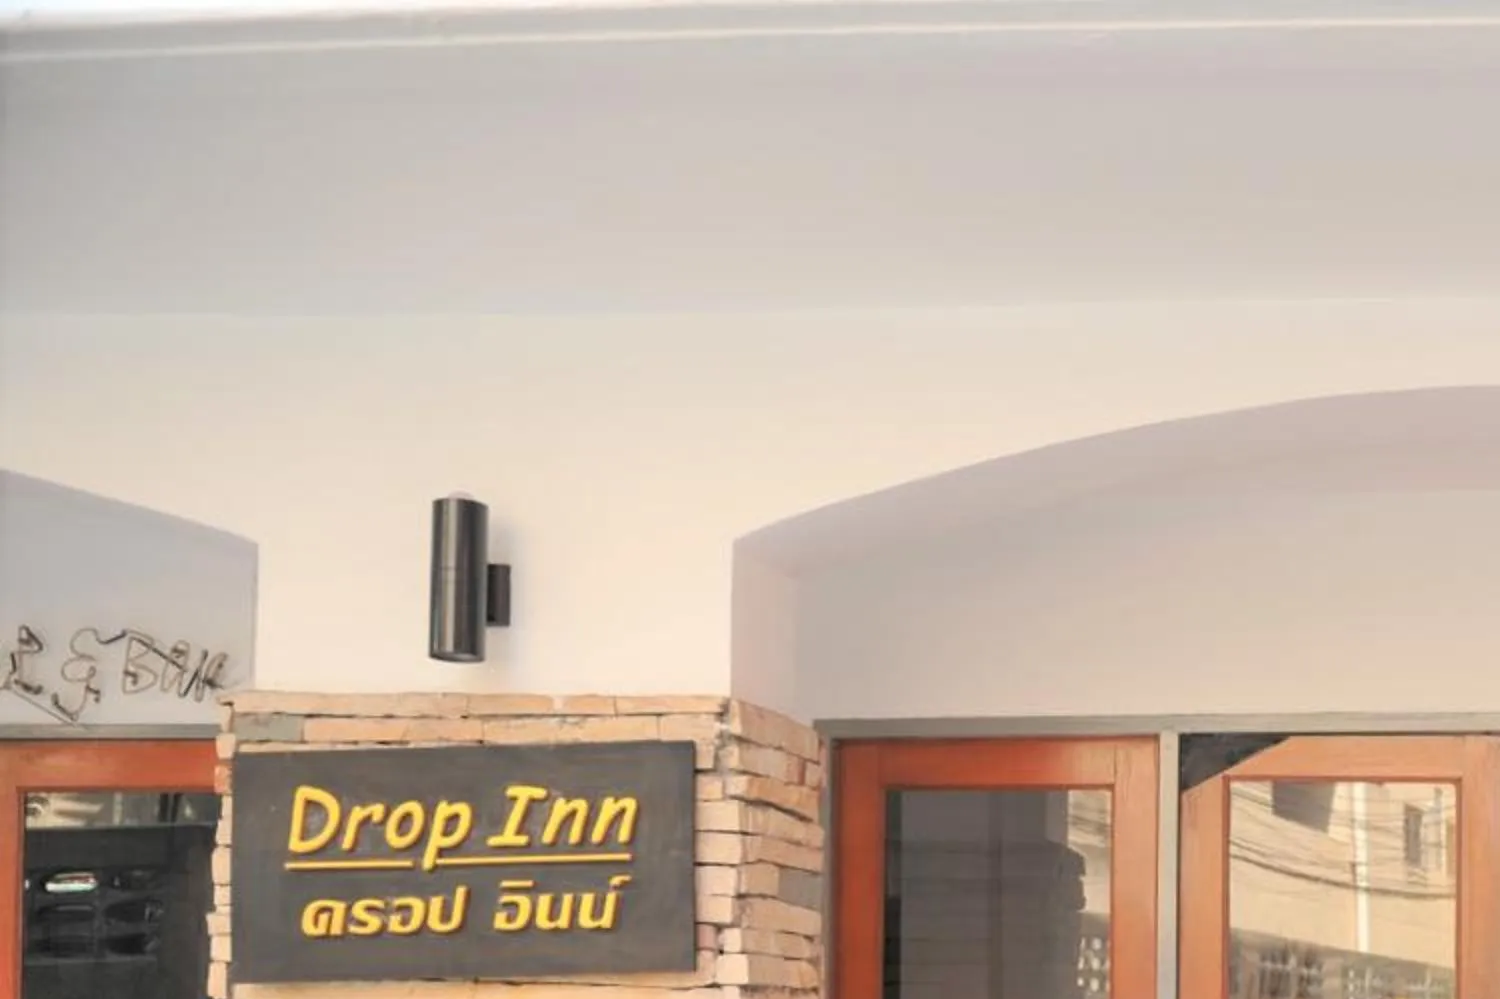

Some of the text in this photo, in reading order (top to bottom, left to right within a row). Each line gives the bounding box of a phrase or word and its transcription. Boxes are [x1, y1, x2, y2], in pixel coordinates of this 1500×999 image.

[287, 784, 639, 871] Drop Inn
[301, 873, 633, 937] ดรอป อินน์
